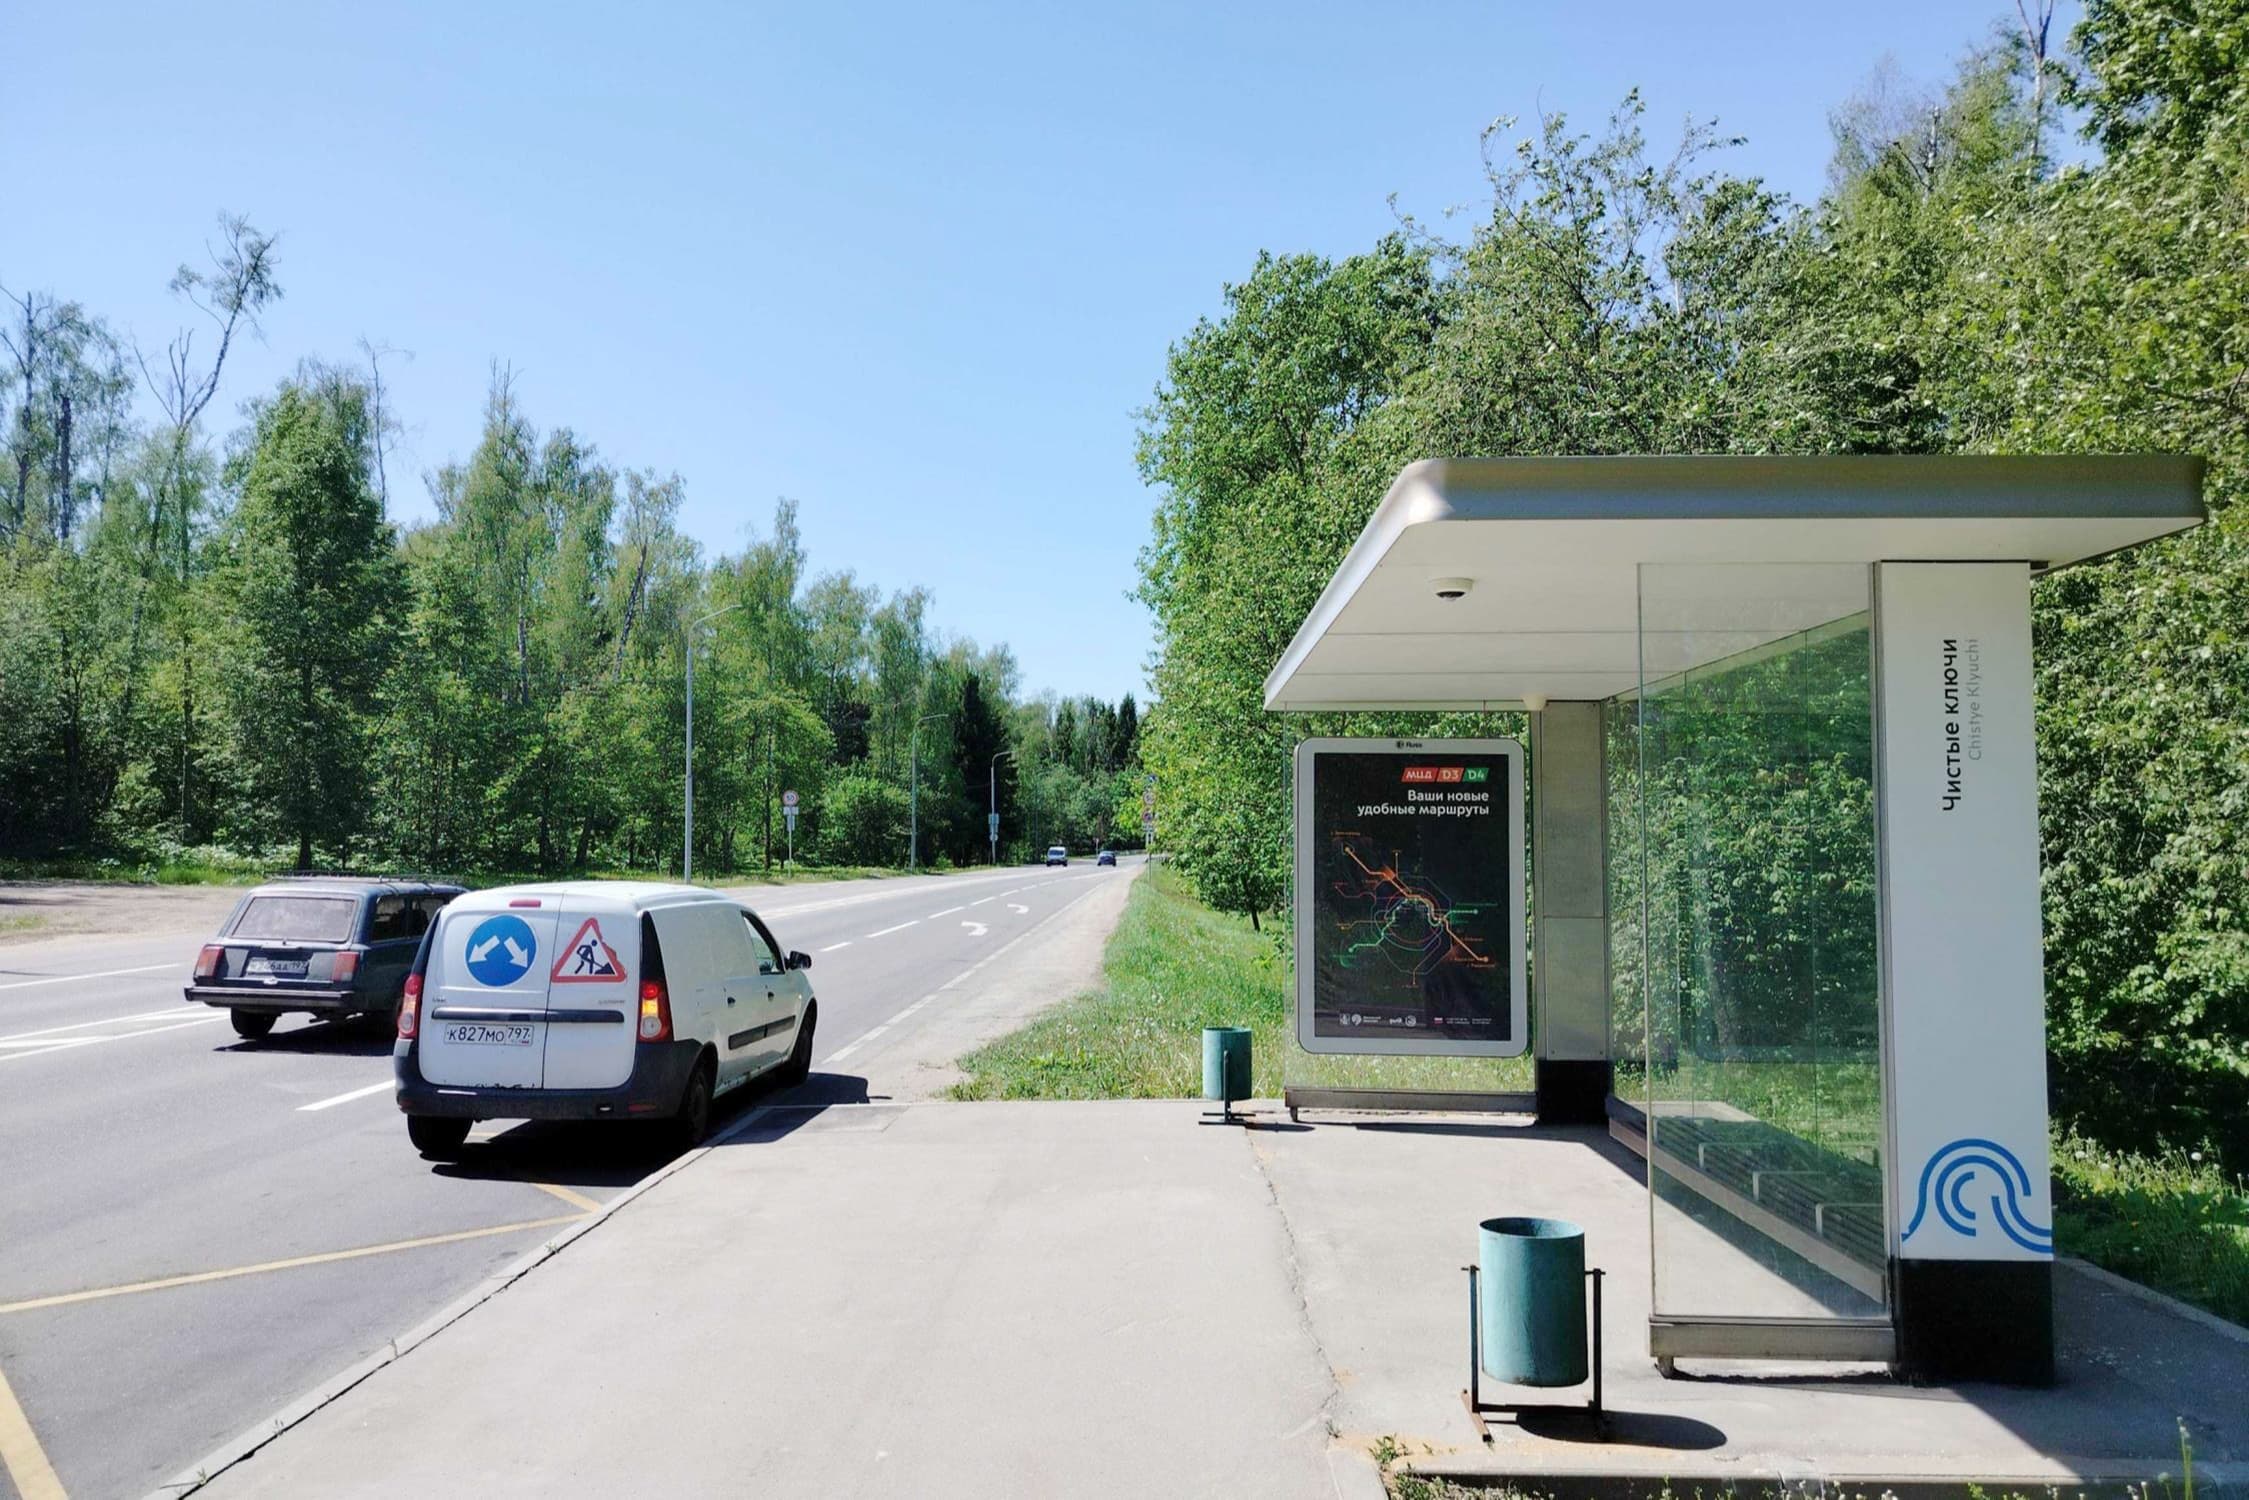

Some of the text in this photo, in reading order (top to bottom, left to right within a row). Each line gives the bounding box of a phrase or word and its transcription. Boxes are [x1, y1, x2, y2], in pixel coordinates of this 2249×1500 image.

[1965, 638, 1984, 761] Chistye Klyuchi
[1942, 639, 1961, 811] Чистые ключи
[1442, 769, 1459, 780] D3
[1467, 769, 1485, 780] D4
[1407, 789, 1489, 802] Ваши новые
[1357, 802, 1489, 818] удобные маршруты
